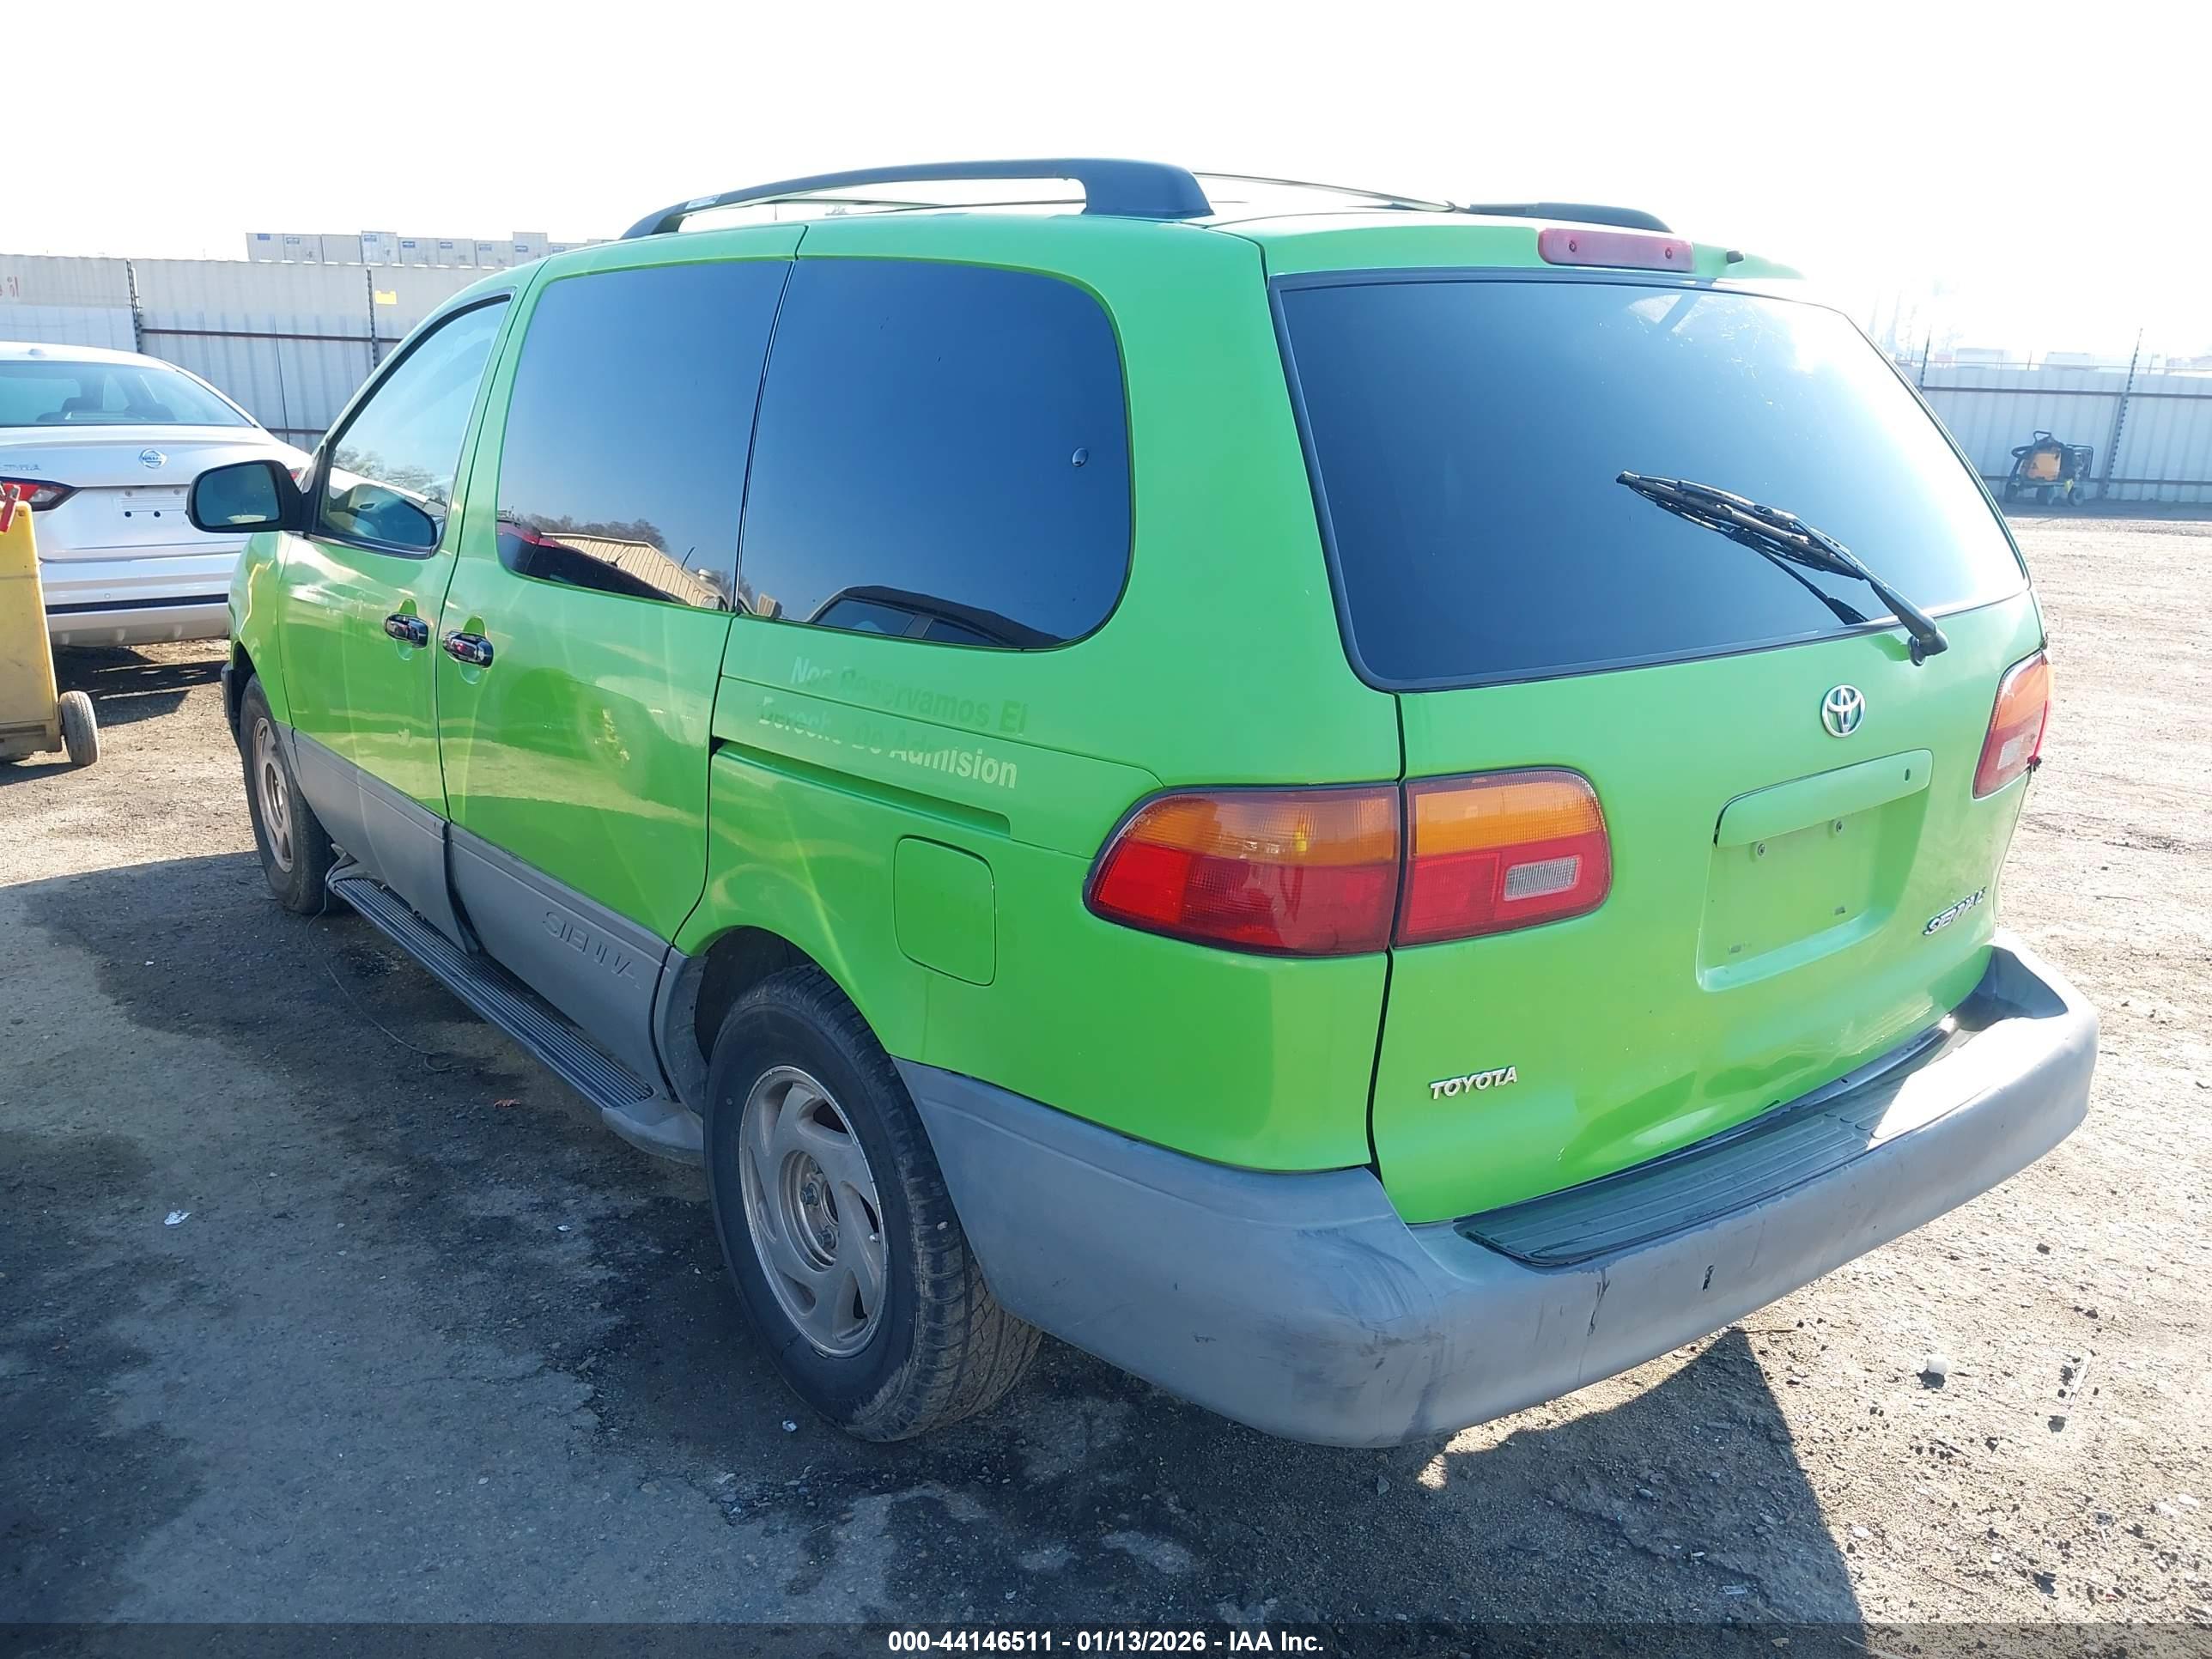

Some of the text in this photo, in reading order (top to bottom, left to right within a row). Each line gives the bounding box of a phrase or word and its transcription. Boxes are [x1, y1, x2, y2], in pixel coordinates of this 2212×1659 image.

[790, 656, 1030, 737] Nos Reservamos El
[888, 728, 1018, 789] Admision
[1430, 1065, 1518, 1100] TOYOTA
